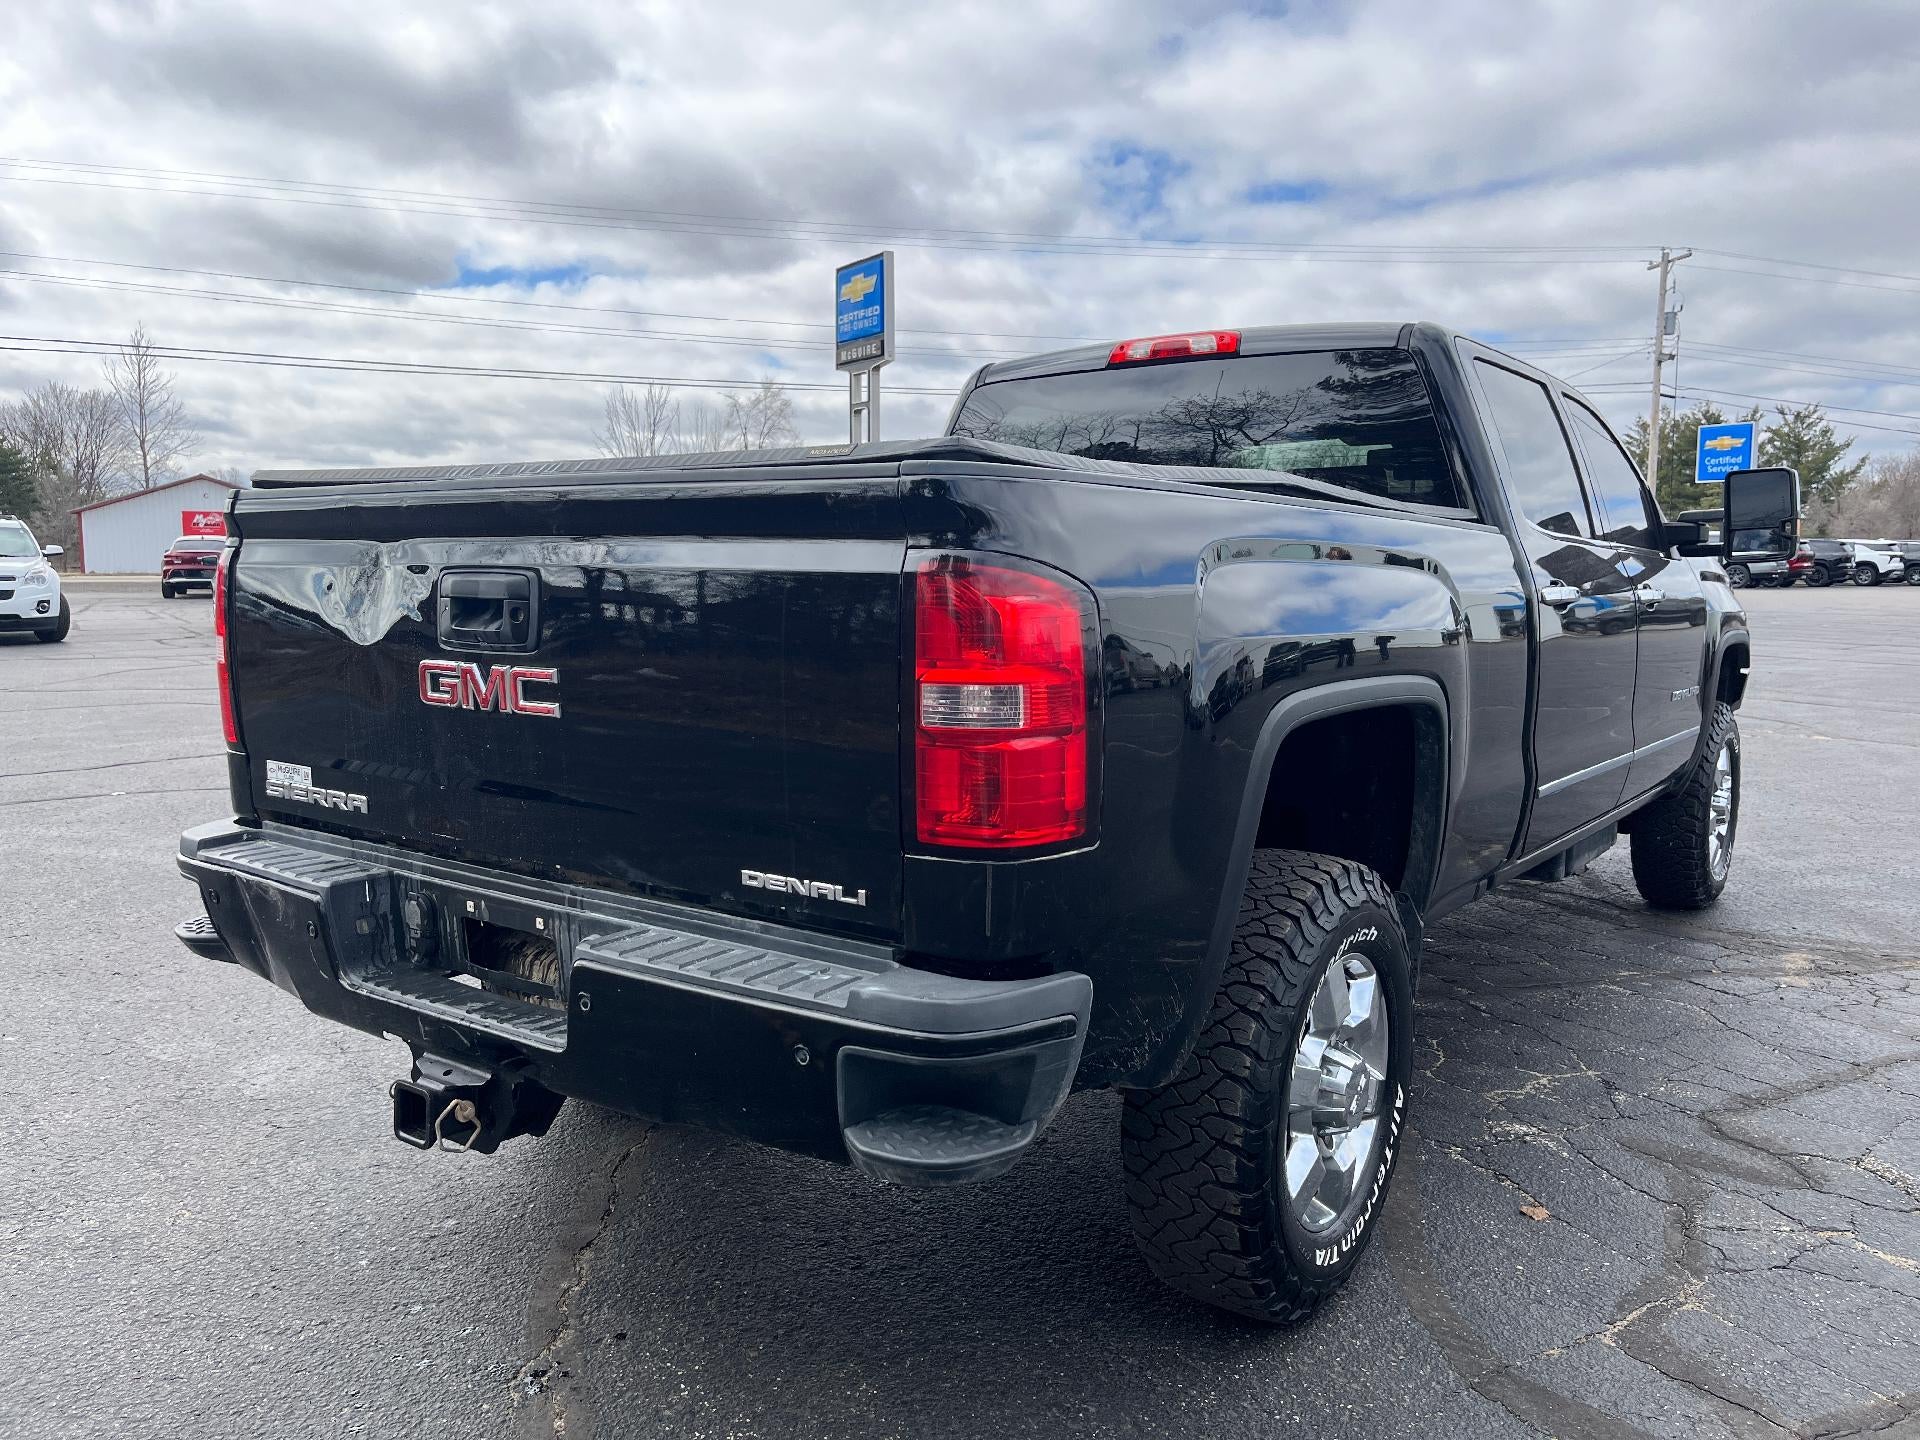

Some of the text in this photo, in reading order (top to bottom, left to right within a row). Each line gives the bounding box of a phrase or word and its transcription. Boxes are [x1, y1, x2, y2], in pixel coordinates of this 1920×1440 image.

[838, 305, 881, 326] CERTIFIED
[841, 343, 877, 361] McGUIRE
[1704, 455, 1743, 466] Certified
[1706, 464, 1740, 473] Service
[418, 659, 561, 718] GMC
[265, 779, 368, 815] SIERRA
[741, 869, 866, 907] DENALI
[1315, 1083, 1404, 1267] All-Terrain T/A
